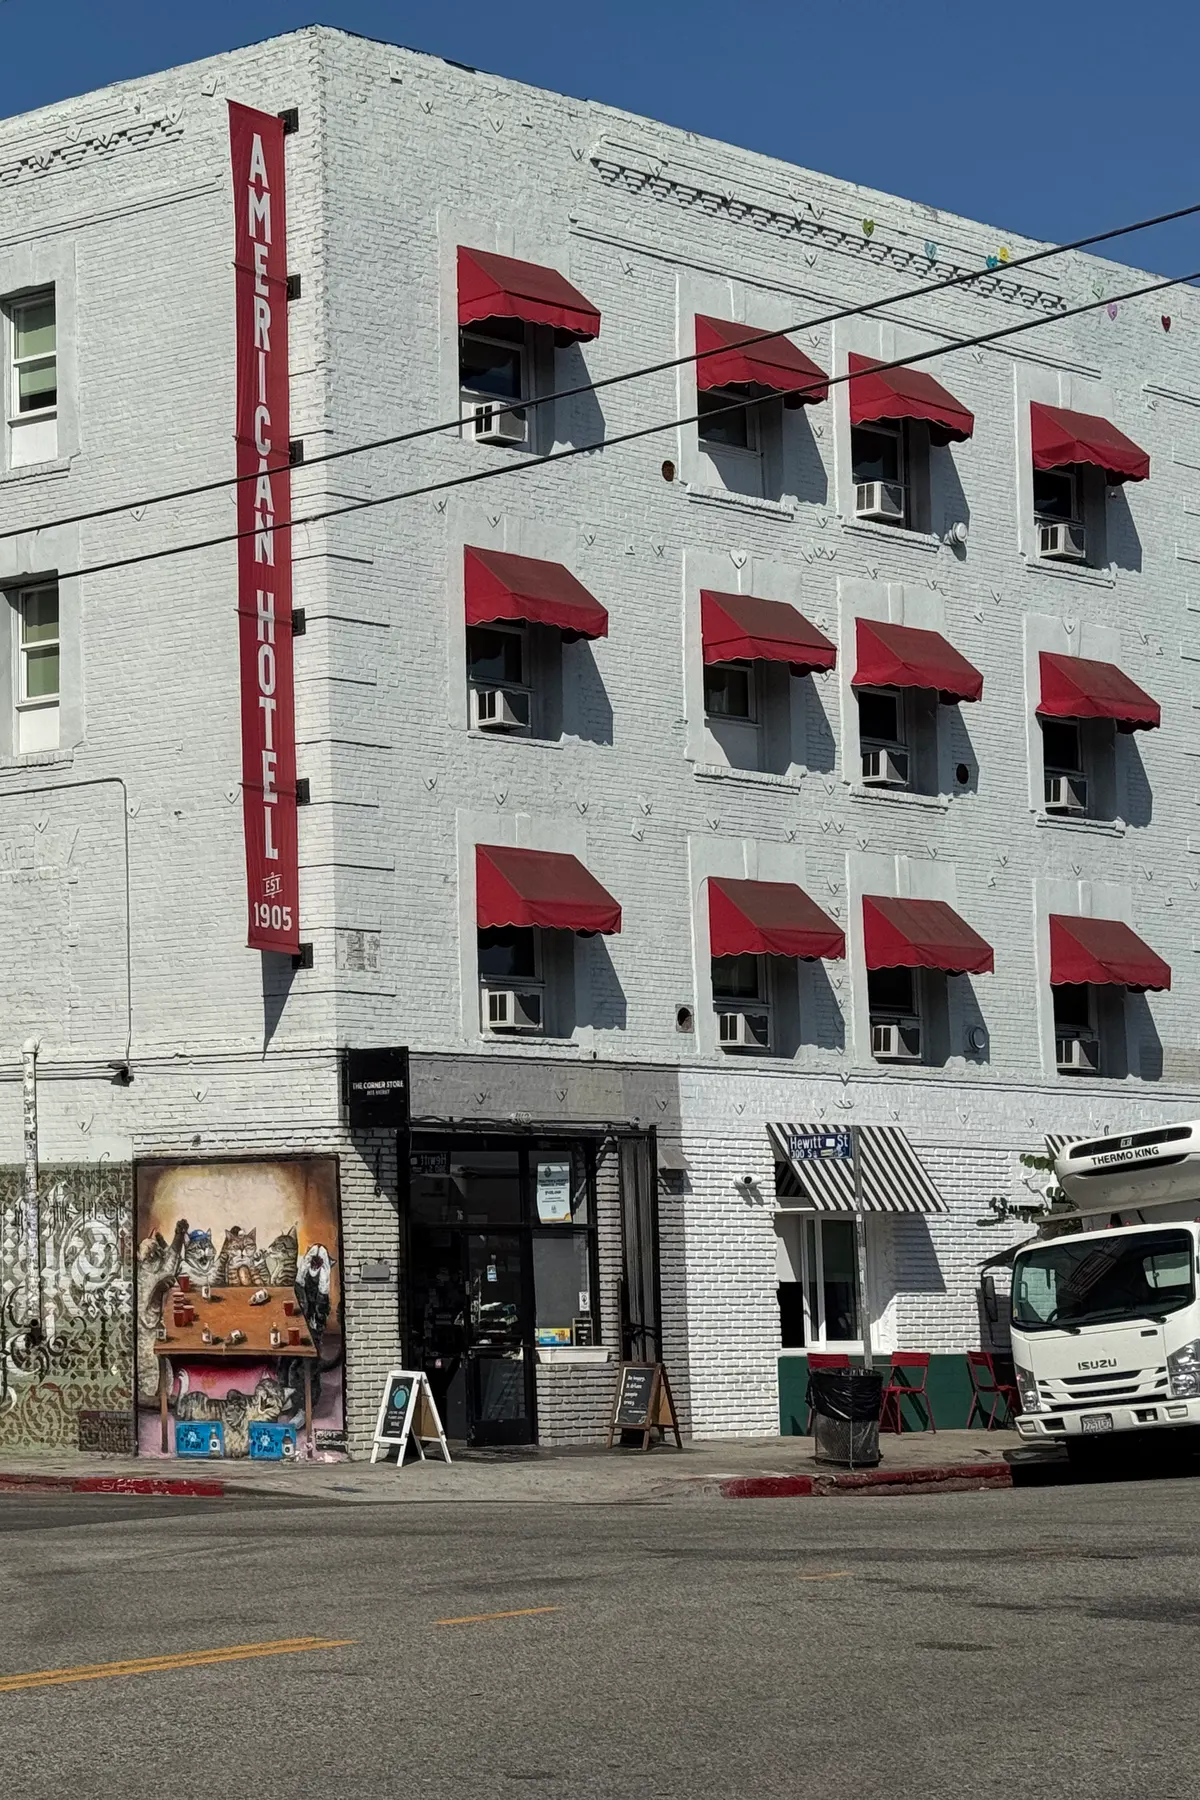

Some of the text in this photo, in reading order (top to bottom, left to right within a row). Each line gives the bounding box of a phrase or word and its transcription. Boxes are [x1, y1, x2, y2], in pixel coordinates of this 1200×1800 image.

[247, 133, 279, 861] AMERICAN HOTEL
[265, 877, 281, 894] EST
[253, 901, 293, 932] 1905
[352, 1080, 404, 1090] THE CORNER STORE
[790, 1135, 848, 1150] Hewitt St
[791, 1149, 805, 1159] 300
[1091, 1146, 1160, 1166] THERMO KING
[1078, 1358, 1117, 1370] ISUZU
